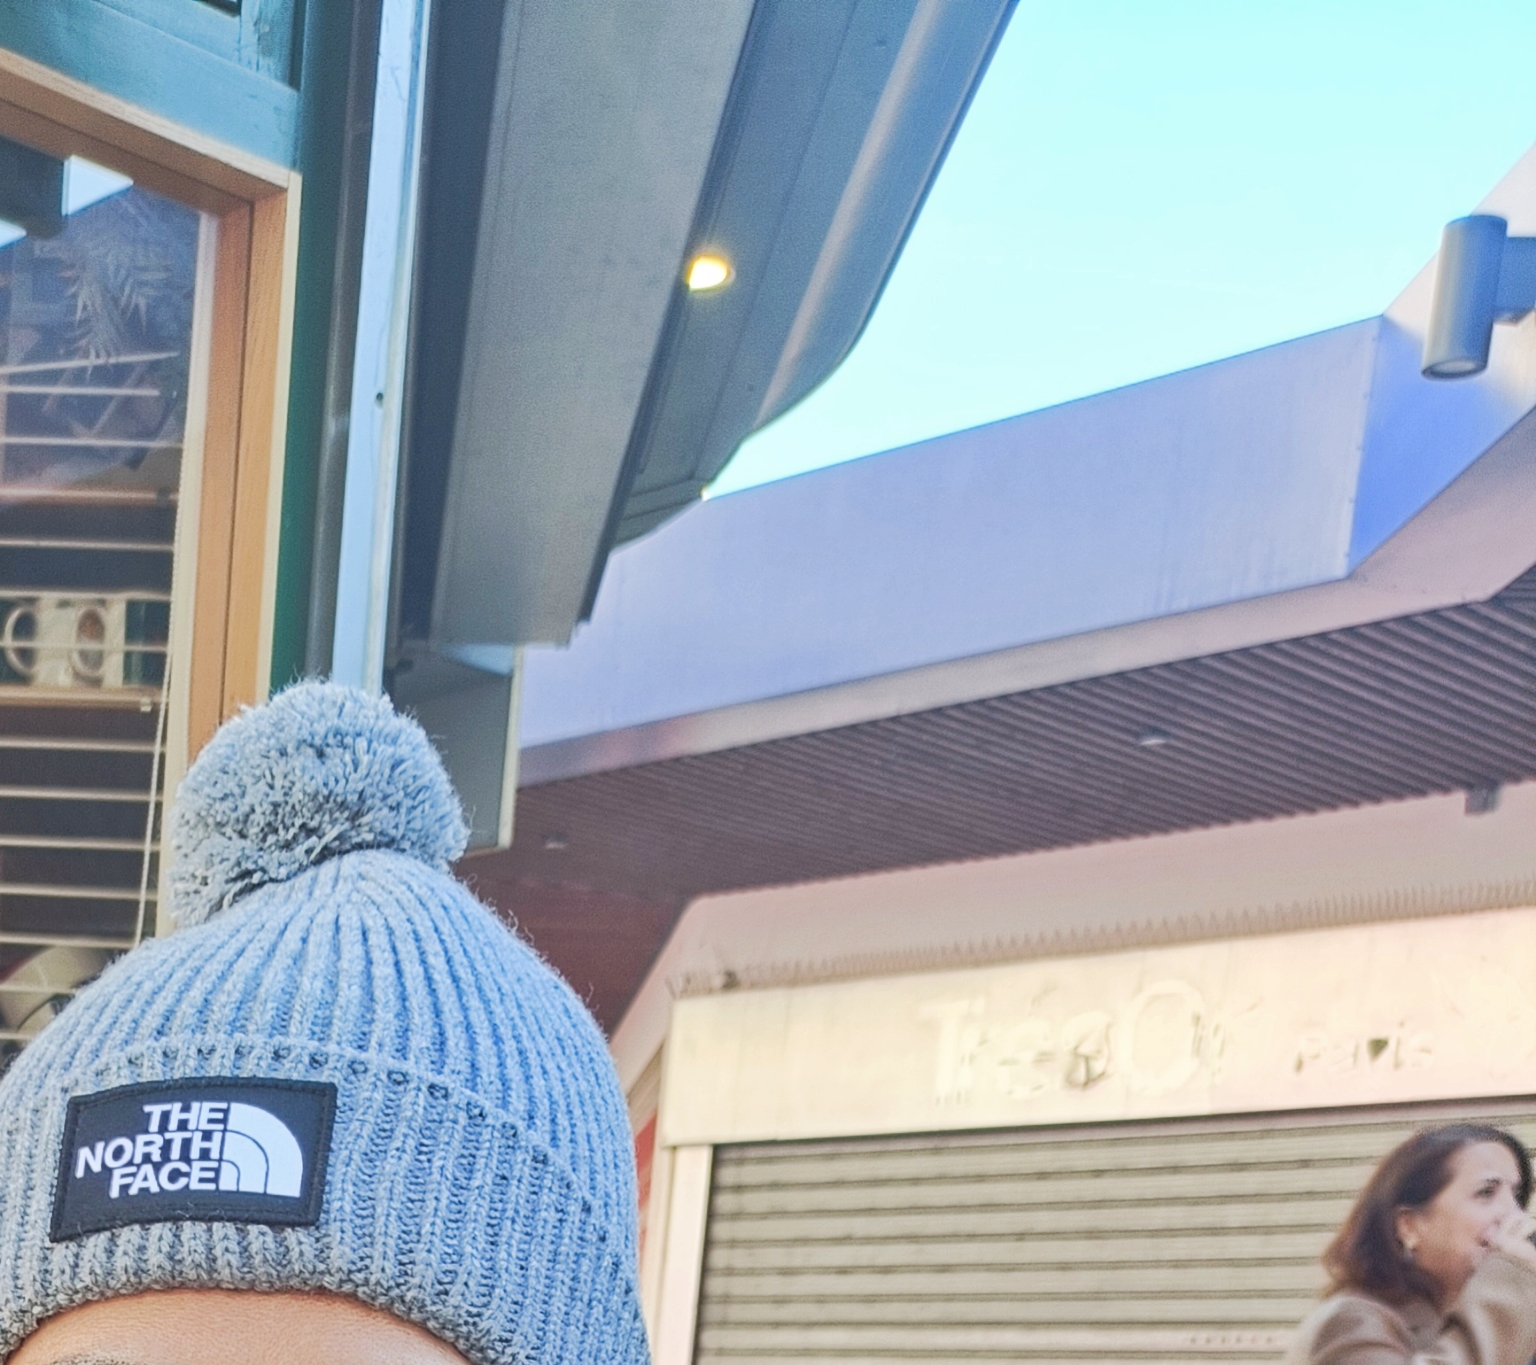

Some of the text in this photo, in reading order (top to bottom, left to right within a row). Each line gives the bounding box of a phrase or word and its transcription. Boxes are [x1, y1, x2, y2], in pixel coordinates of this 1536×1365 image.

[143, 1101, 228, 1133] THE
[74, 1131, 223, 1179] NORTH
[109, 1160, 222, 1199] FACE
